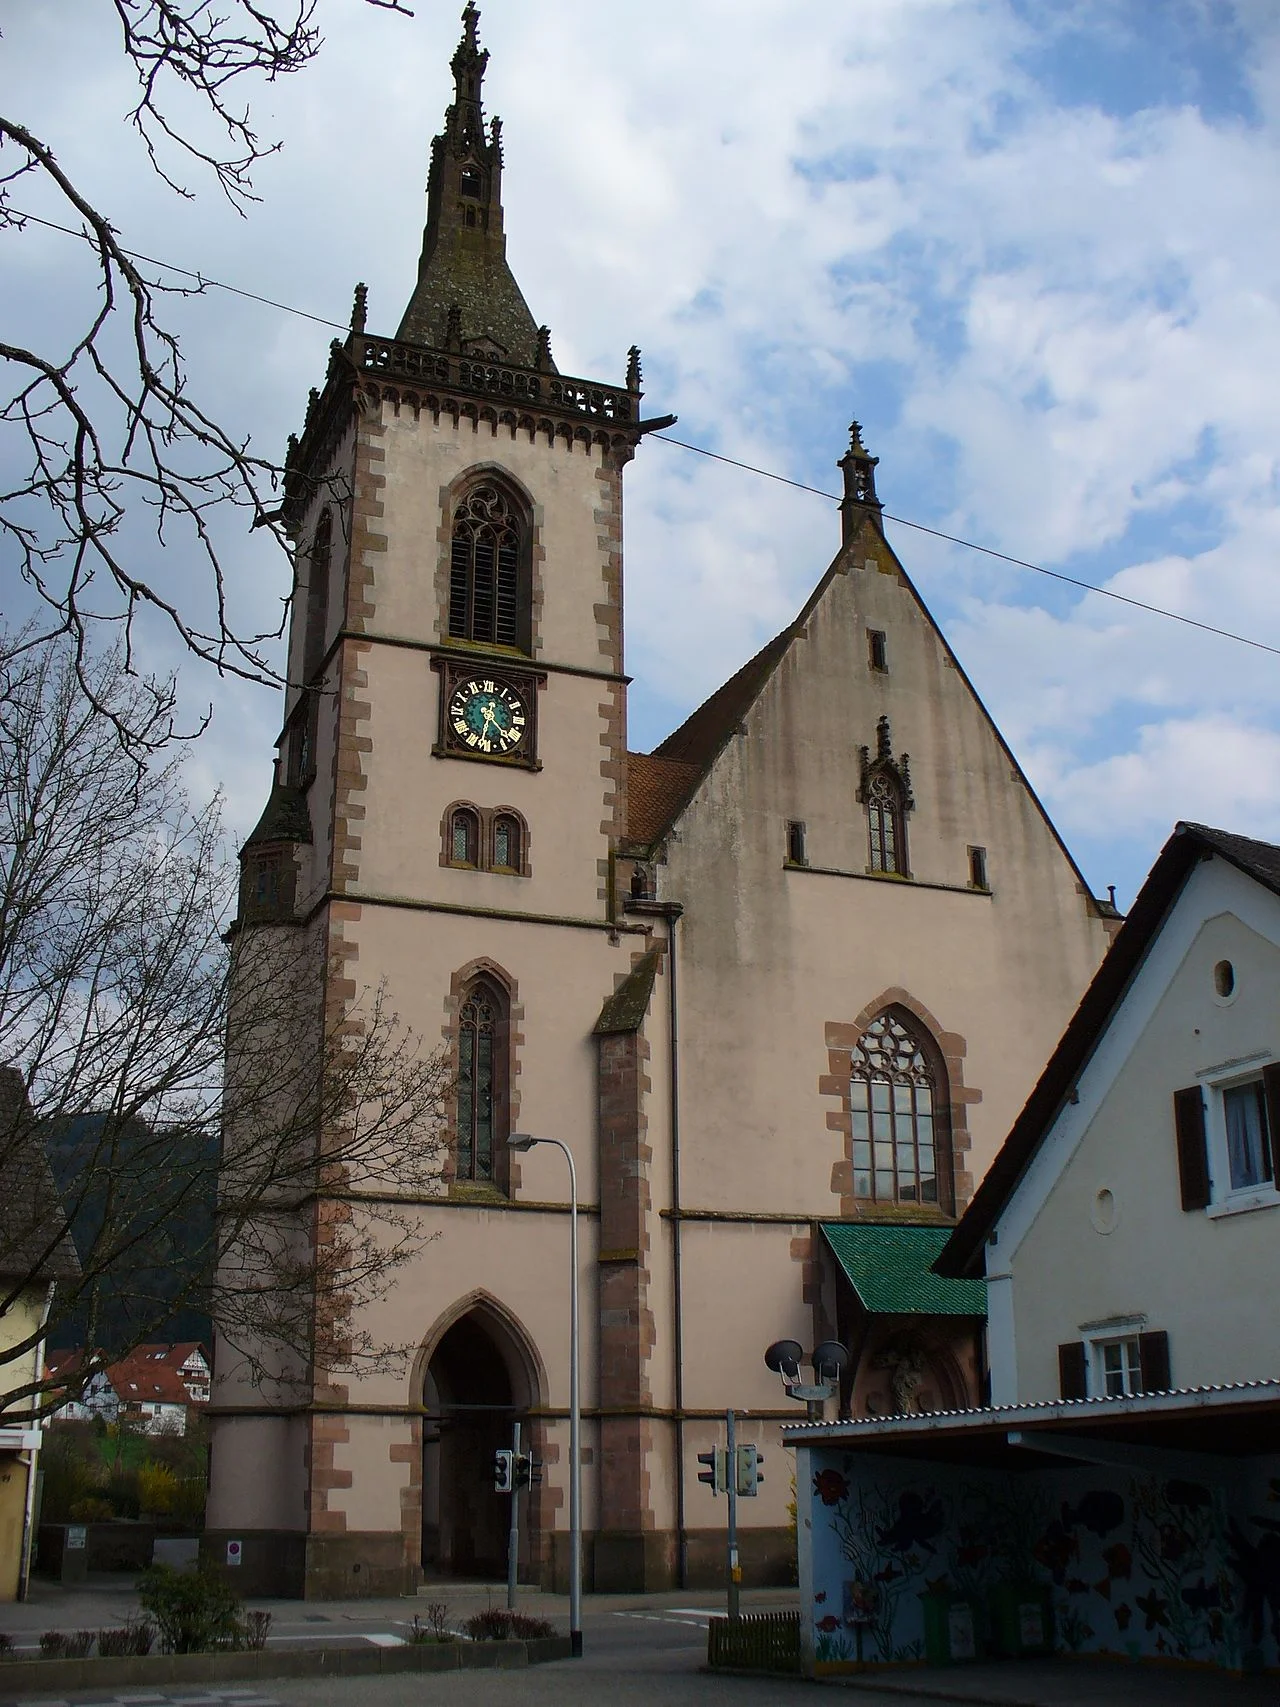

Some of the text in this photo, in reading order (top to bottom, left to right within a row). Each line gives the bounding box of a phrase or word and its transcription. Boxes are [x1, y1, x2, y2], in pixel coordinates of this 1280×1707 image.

[483, 680, 494, 693] XII
[455, 691, 469, 703] X
[500, 687, 509, 698] I
[451, 705, 464, 716] IX
[509, 701, 521, 710] II
